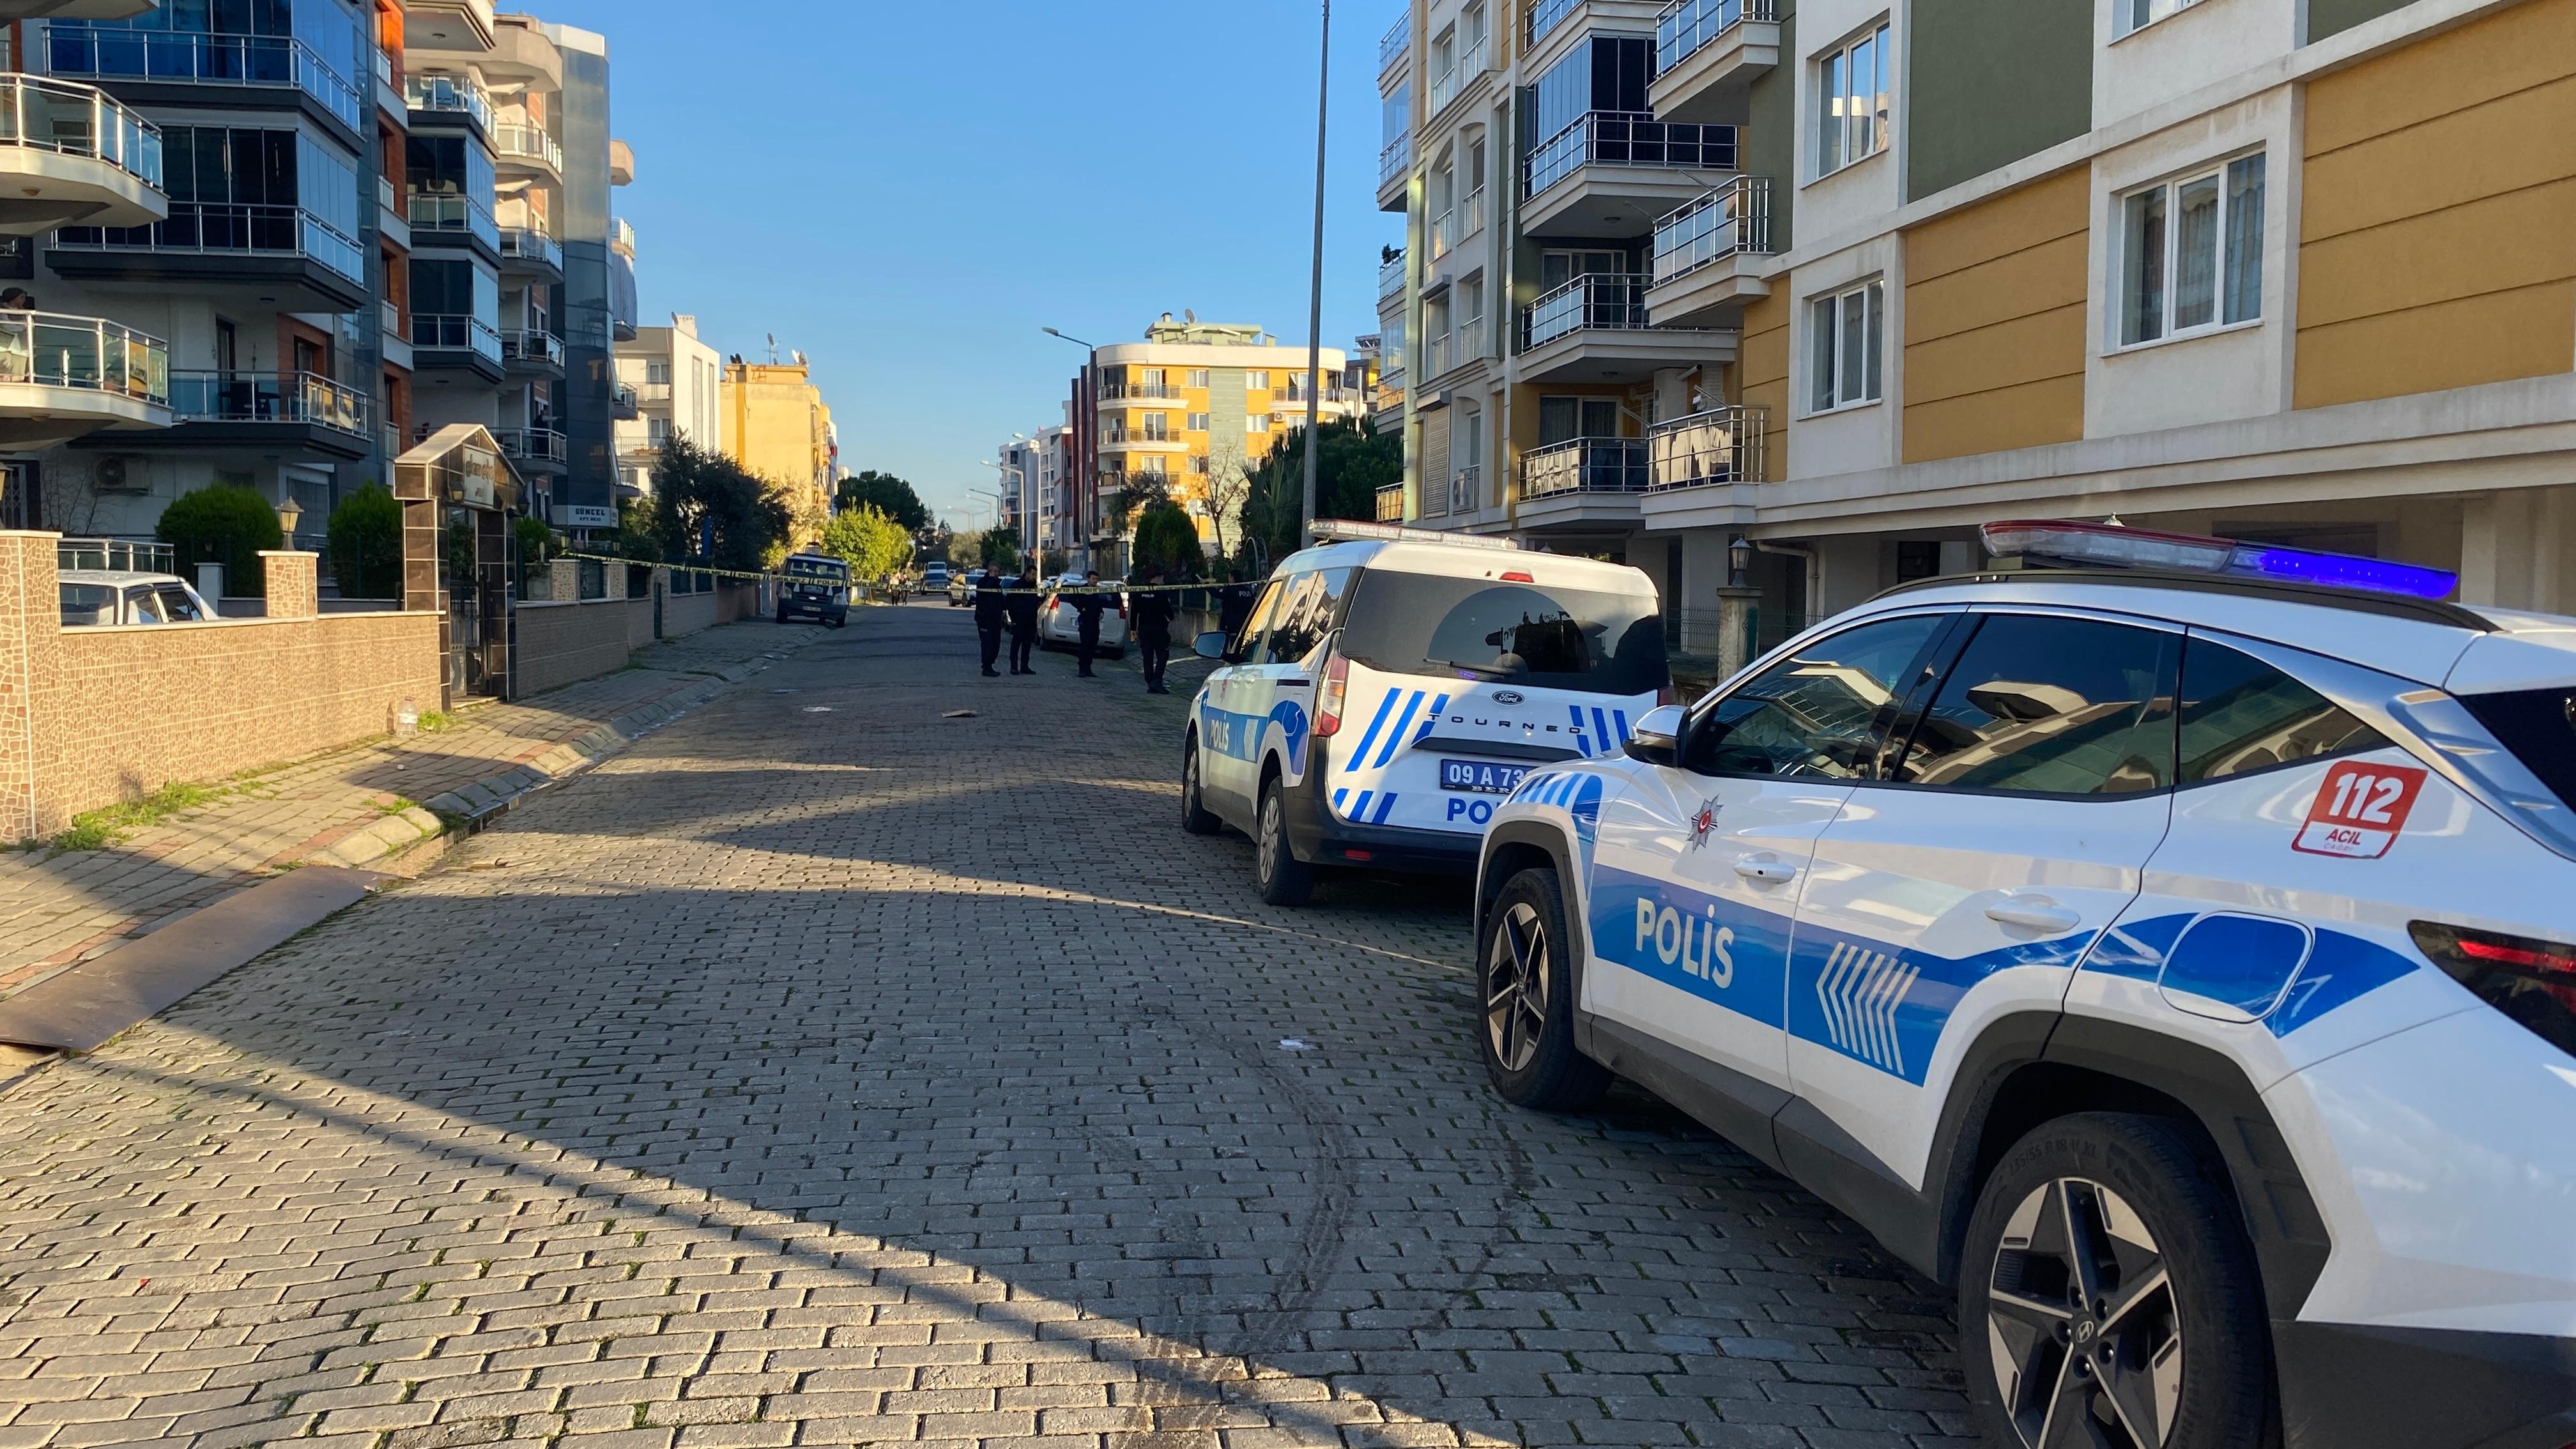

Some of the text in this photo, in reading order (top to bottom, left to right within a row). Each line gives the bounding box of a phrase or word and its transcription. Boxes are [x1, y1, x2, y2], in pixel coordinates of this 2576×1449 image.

[1499, 692, 1519, 703] Ford
[1428, 714, 1581, 734] TOURNEO
[1449, 764, 1525, 788] 09 A 73
[1471, 785, 1510, 795] BER
[2328, 772, 2404, 824] 112
[1446, 797, 1501, 825] PO
